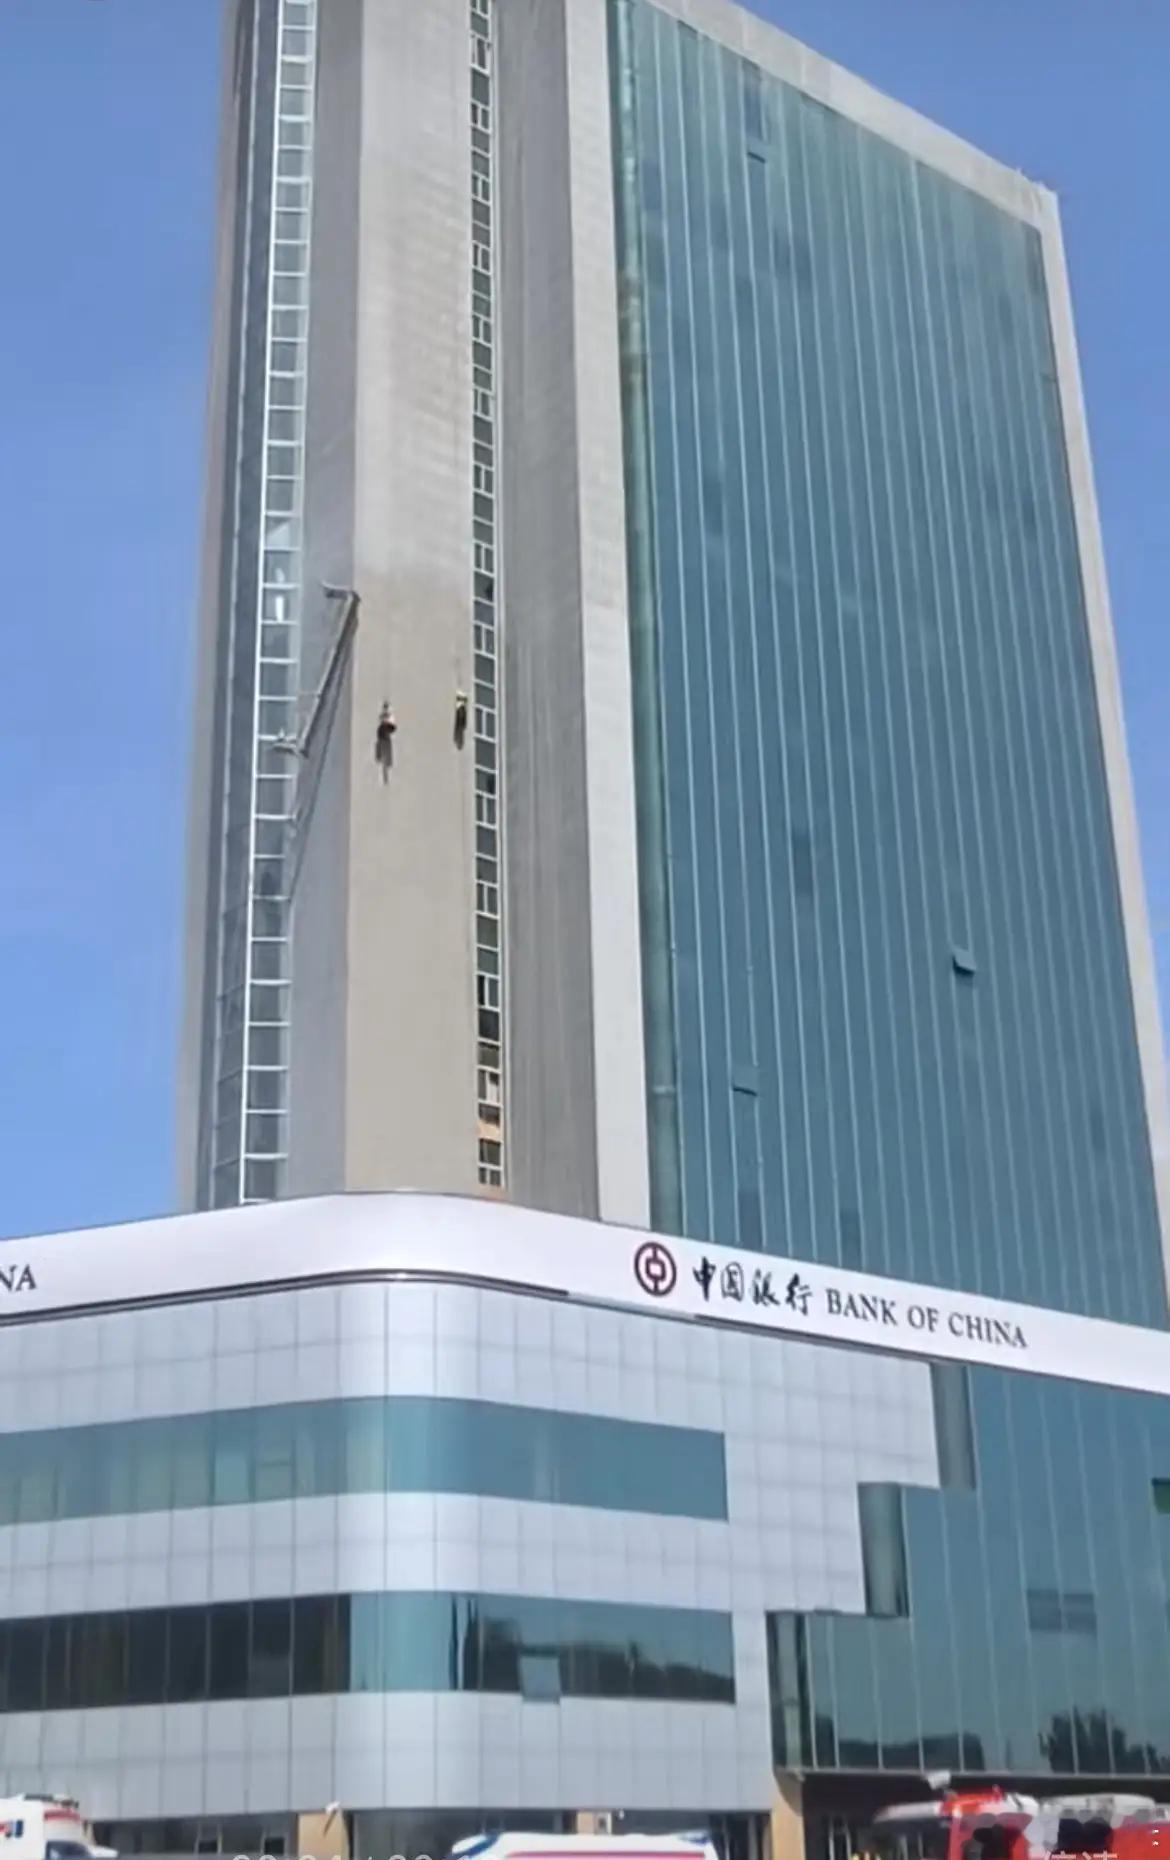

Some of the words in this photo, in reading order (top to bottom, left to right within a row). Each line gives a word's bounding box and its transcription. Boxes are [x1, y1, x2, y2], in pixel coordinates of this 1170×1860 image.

[692, 1256, 813, 1316] 中国银行
[826, 1288, 898, 1326] BANK
[907, 1306, 939, 1332] OF
[948, 1312, 1027, 1348] CHINA
